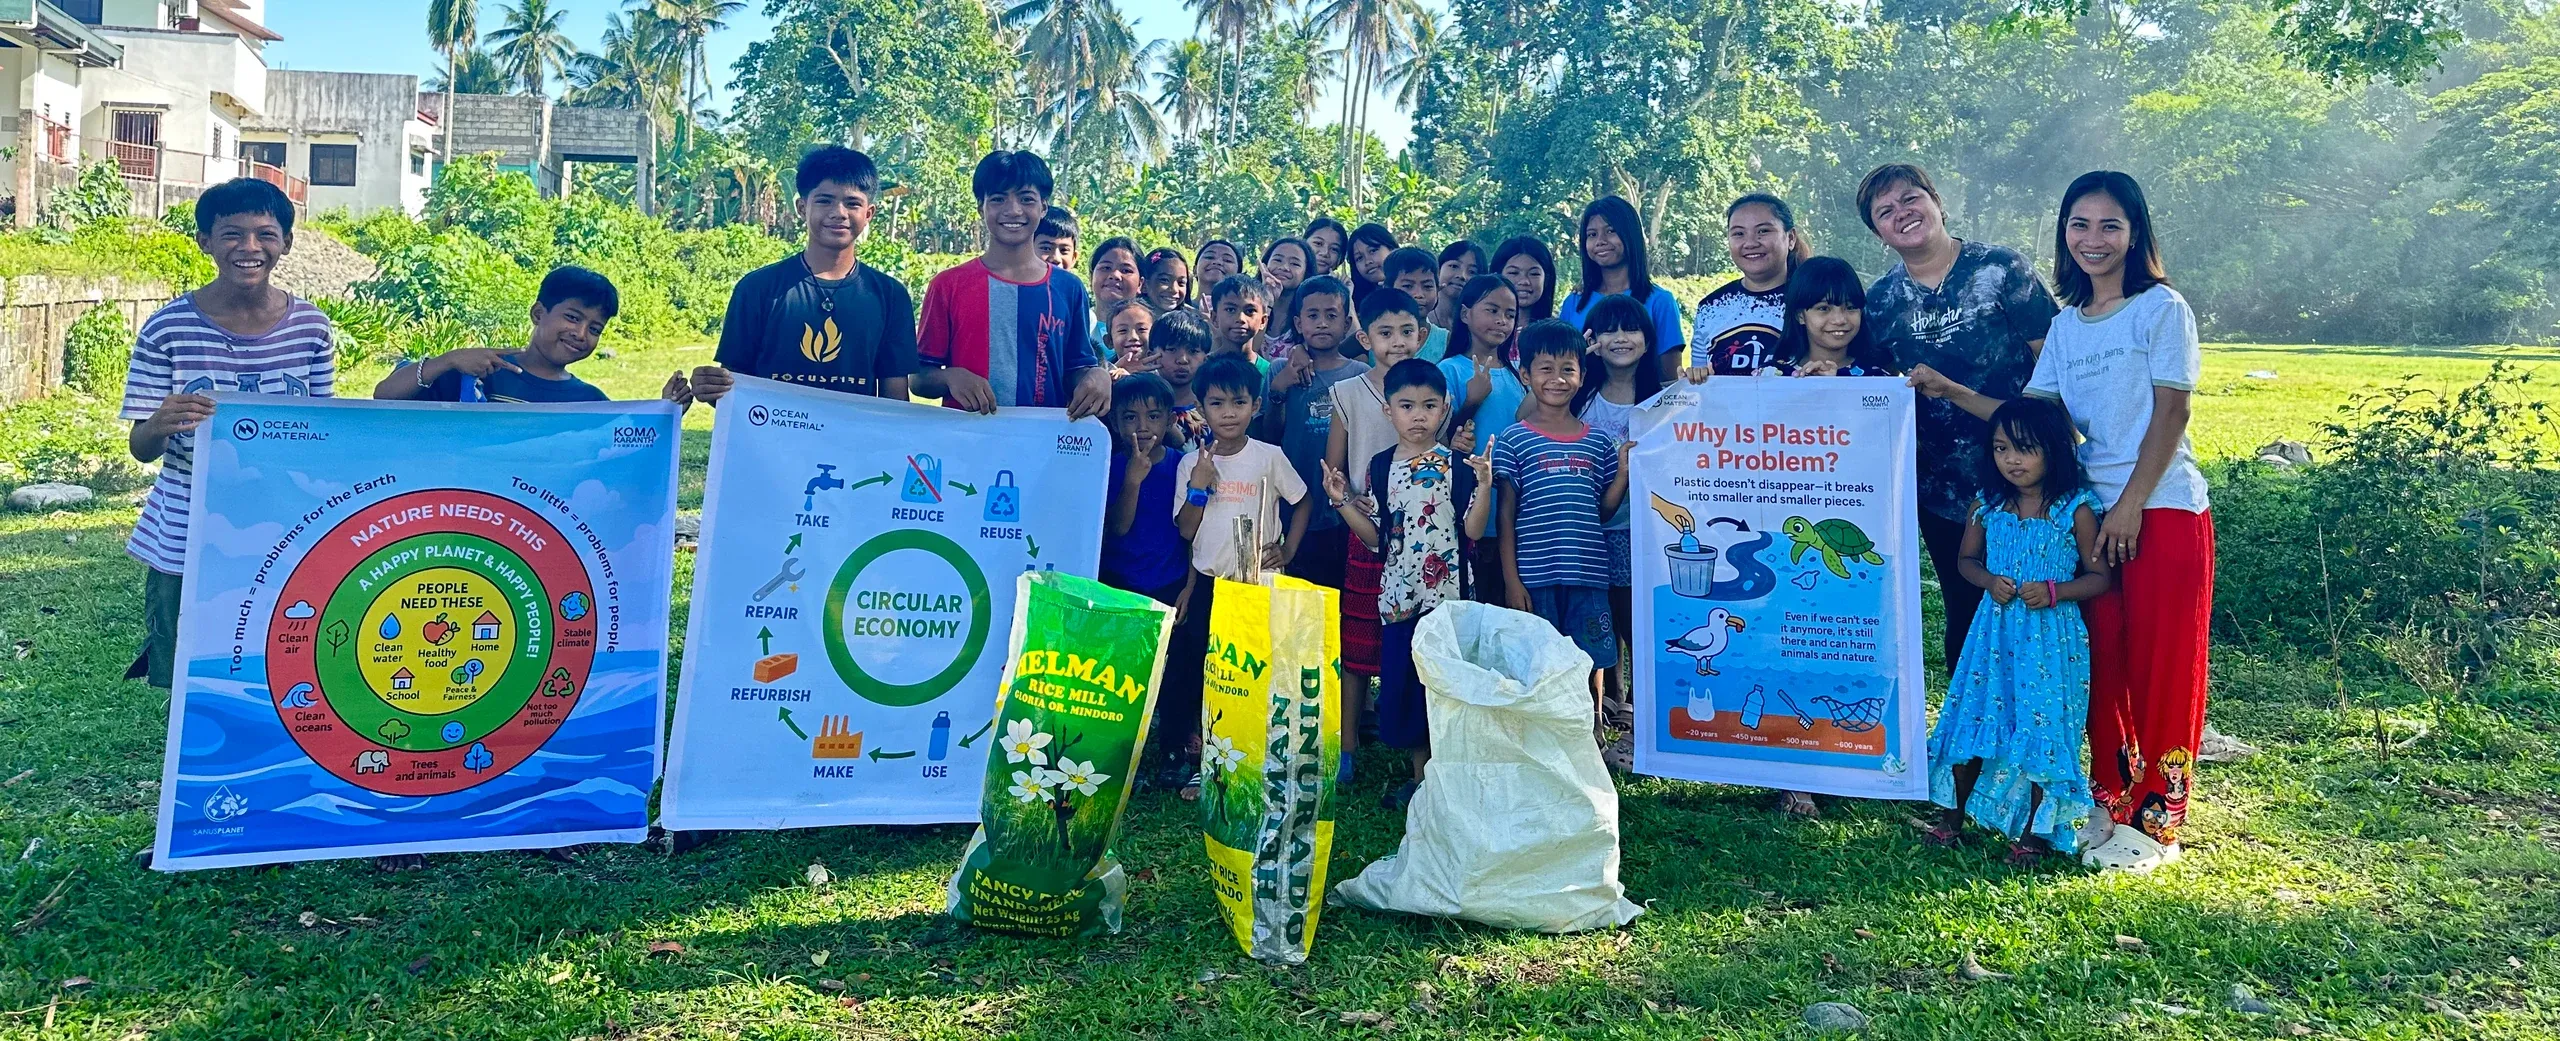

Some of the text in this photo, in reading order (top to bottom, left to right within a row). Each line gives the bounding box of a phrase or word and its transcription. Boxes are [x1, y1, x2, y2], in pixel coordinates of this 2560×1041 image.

[771, 373, 866, 385] FOCUSFIRE
[1862, 395, 1890, 403] KOMA
[772, 408, 809, 419] OCEAN
[263, 420, 309, 430] OCEAN
[614, 426, 657, 437] KOMA
[1057, 434, 1092, 446] KOMA
[1673, 421, 1851, 448] Why Is Plastic
[1057, 444, 1090, 452] KARANTH
[1696, 450, 1839, 473] a Problem?
[353, 473, 397, 495] Earth
[512, 476, 538, 495] Too
[1674, 477, 1711, 488] Plastic
[1713, 478, 1756, 490] doesn't
[1835, 482, 1874, 493] breaks
[326, 490, 351, 509] the
[539, 488, 570, 514] little
[1688, 491, 1865, 508] into smaller and smaller pieces.
[303, 505, 325, 525] for
[795, 513, 829, 528] TAKE
[891, 507, 944, 523] REDUCE
[350, 503, 547, 552] NATURE NEEDS THIS
[979, 526, 1022, 540] REUSE
[255, 524, 304, 584] problems
[576, 521, 614, 579] problems
[417, 582, 469, 594] PEOPLE
[607, 580, 619, 601] for
[358, 545, 541, 659] A HAPPY PLANET & HAPPY PEOPLE!
[401, 596, 484, 609] NEED THESE
[856, 590, 962, 614] CIRCULAR
[235, 599, 253, 640] much
[745, 605, 798, 620] REPAIR
[1785, 611, 1879, 626] Even if we can't see
[564, 628, 592, 637] Stable
[607, 605, 620, 654] people
[853, 617, 961, 639] ECONOMY
[1781, 624, 1873, 637] it anymore, it's still
[278, 633, 309, 643] Clean
[557, 639, 590, 647] climate
[1781, 636, 1876, 650] there and can harm
[285, 645, 300, 654] air
[374, 643, 403, 652] Clean
[418, 648, 457, 659] Healthy
[471, 643, 500, 651] Home
[230, 645, 243, 675] Too
[373, 654, 403, 663] water
[1781, 649, 1877, 662] animals and nature.
[425, 658, 448, 668] food
[386, 691, 420, 701] School
[446, 685, 477, 694] Peace &
[731, 687, 811, 703] REFURBISH
[1028, 678, 1107, 706] RICE MILL
[443, 693, 477, 701] Fairness
[526, 703, 541, 711] Not
[1014, 689, 1124, 722] GLORIA OR. MINDORO
[295, 711, 325, 721] Clean
[523, 718, 561, 727] pollution
[294, 722, 333, 732] oceans
[1700, 730, 1718, 738] years
[1750, 734, 1768, 742] years
[1801, 738, 1819, 746] years
[410, 760, 438, 769] Trees
[395, 769, 456, 781] and animals
[813, 765, 854, 779] MAKE
[922, 765, 948, 779] USE
[1286, 665, 1320, 946] DINURADO
[192, 826, 244, 836] SANUSPLANET
[1219, 865, 1239, 885] RICE
[975, 868, 1033, 900] FANCY
[973, 902, 994, 917] Net
[997, 908, 1043, 924] Weight:
[1046, 915, 1060, 925] 25
